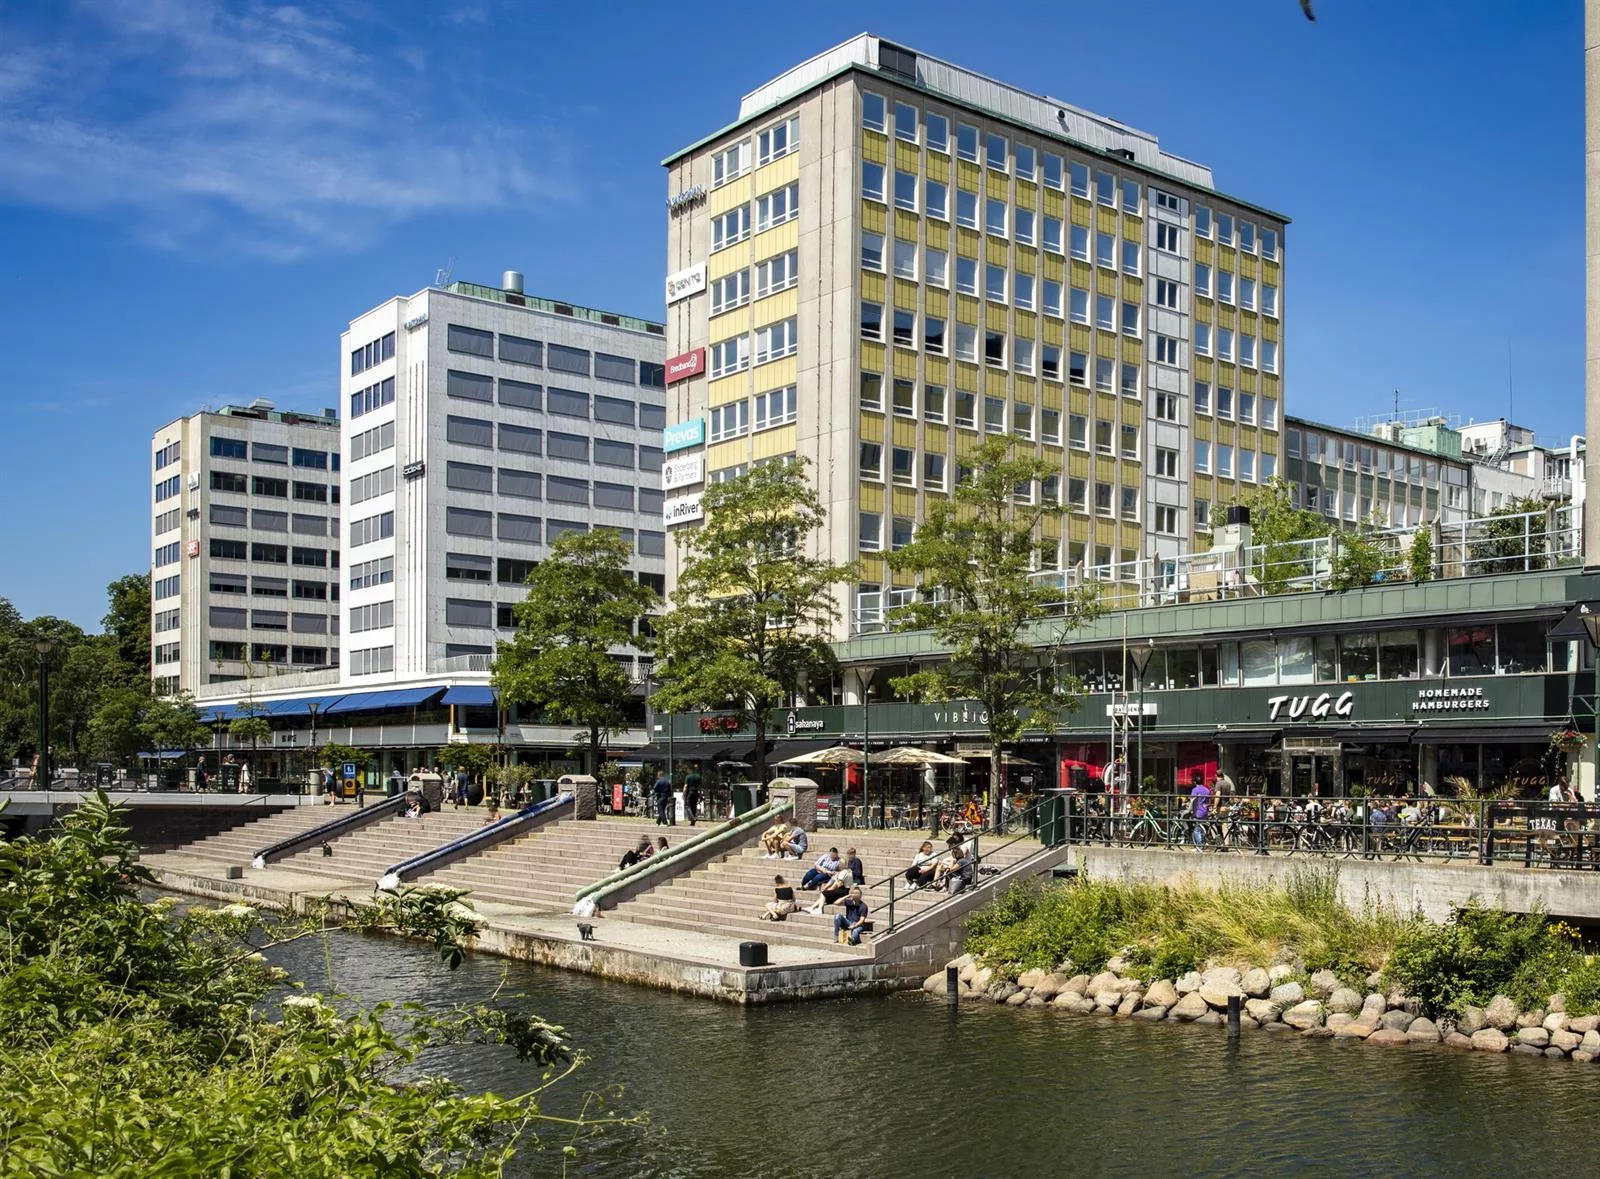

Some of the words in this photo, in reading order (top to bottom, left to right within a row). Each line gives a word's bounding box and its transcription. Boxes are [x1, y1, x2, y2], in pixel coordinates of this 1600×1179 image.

[665, 427, 699, 447] Prevas
[673, 503, 699, 517] inRiver
[1418, 687, 1483, 698] HOMEMADE
[1267, 691, 1353, 720] TUGG
[1412, 699, 1490, 710] HAMBURGERS
[795, 719, 824, 730] sahanaya
[1510, 776, 1546, 785] TUGG
[1529, 817, 1557, 831] TEXAS
